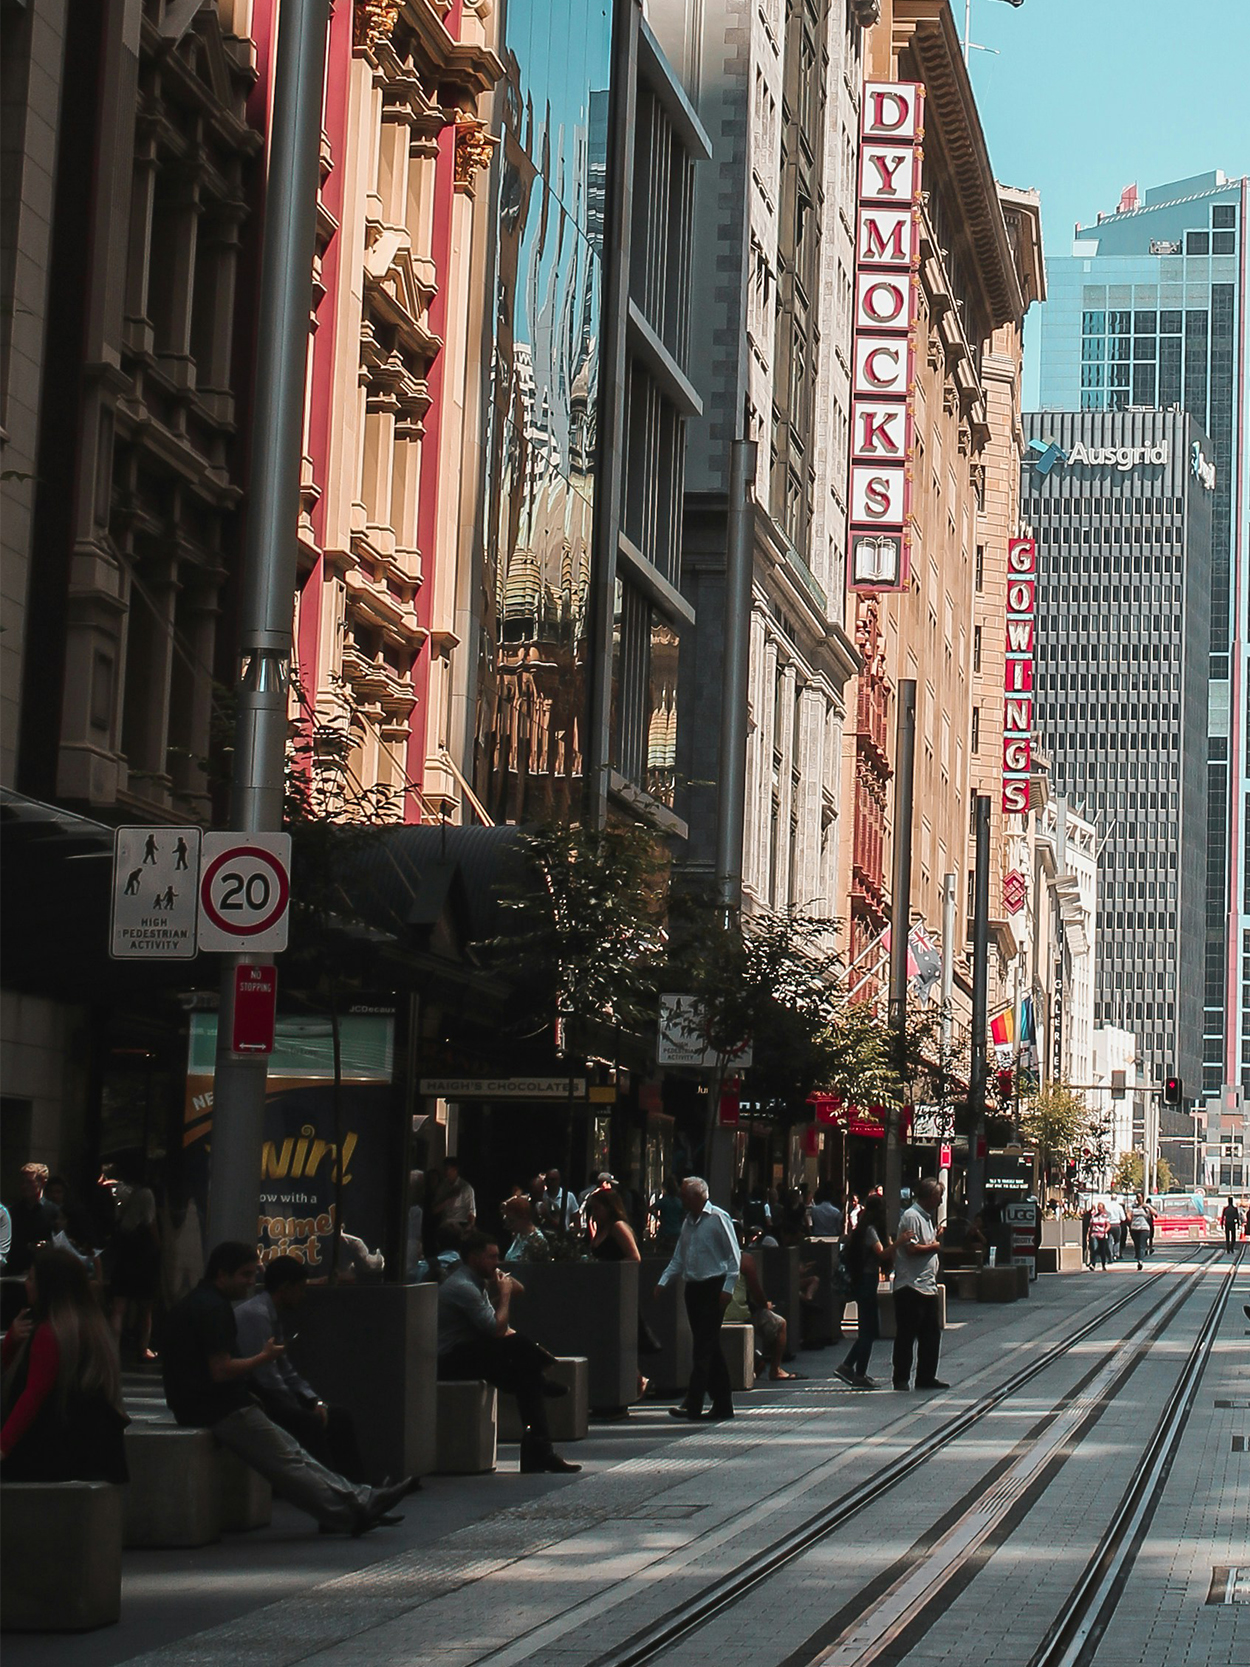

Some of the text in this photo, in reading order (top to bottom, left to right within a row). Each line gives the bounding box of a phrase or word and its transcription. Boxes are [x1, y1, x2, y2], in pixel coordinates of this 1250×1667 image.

[859, 91, 909, 519] DYMOCKS
[1067, 440, 1168, 471] Ausgrid
[1005, 542, 1031, 810] GOWINGS
[220, 872, 270, 910] 20
[141, 918, 167, 926] HIGH
[122, 929, 188, 938] PEDESTRIAN
[130, 940, 179, 949] ACTIVITY
[250, 970, 261, 979] NO
[239, 982, 271, 992] STOPPING
[427, 1081, 579, 1092] HAIGH'S CHOCOLATES
[192, 1091, 214, 1111] NE
[259, 1193, 318, 1204] ow with a
